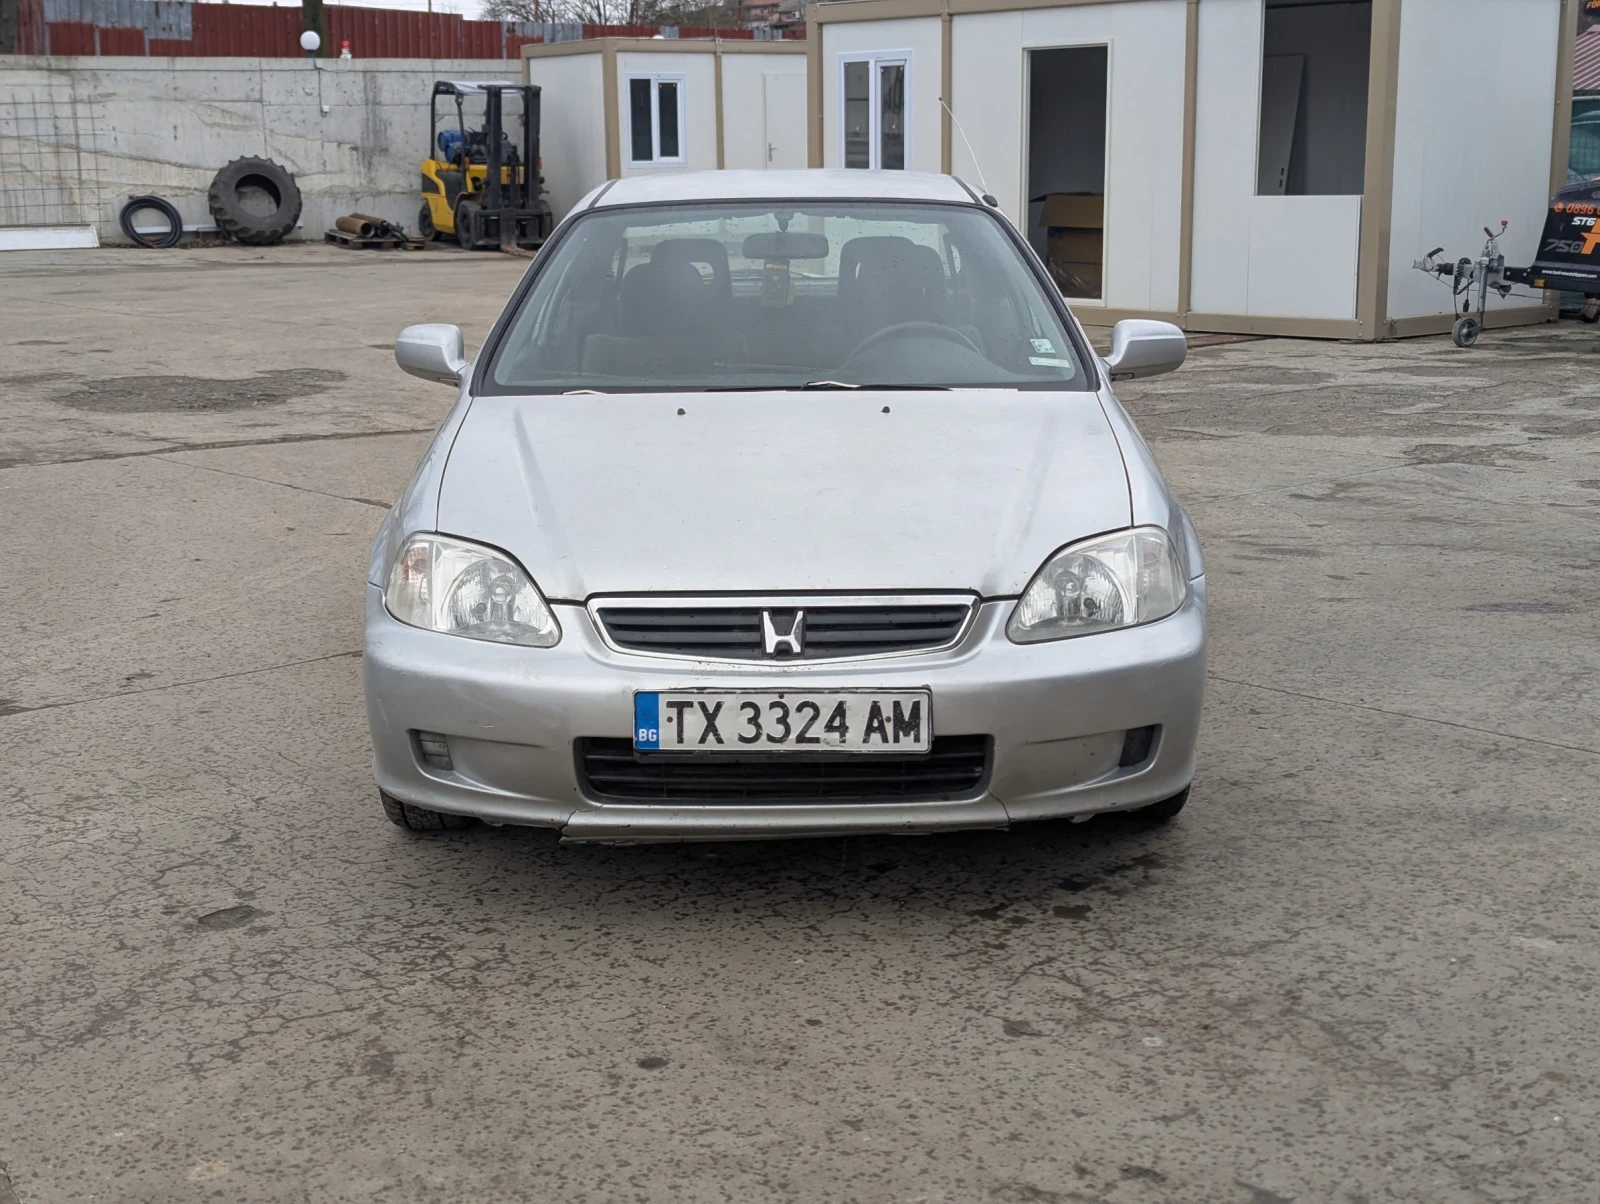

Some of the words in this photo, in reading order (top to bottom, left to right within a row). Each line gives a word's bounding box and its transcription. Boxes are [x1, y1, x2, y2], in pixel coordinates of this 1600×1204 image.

[1566, 203, 1595, 215] 0896
[1571, 216, 1597, 226] ST6
[666, 700, 725, 744] TX
[737, 700, 849, 744] 3324
[861, 700, 922, 744] AM
[638, 728, 657, 742] BG
